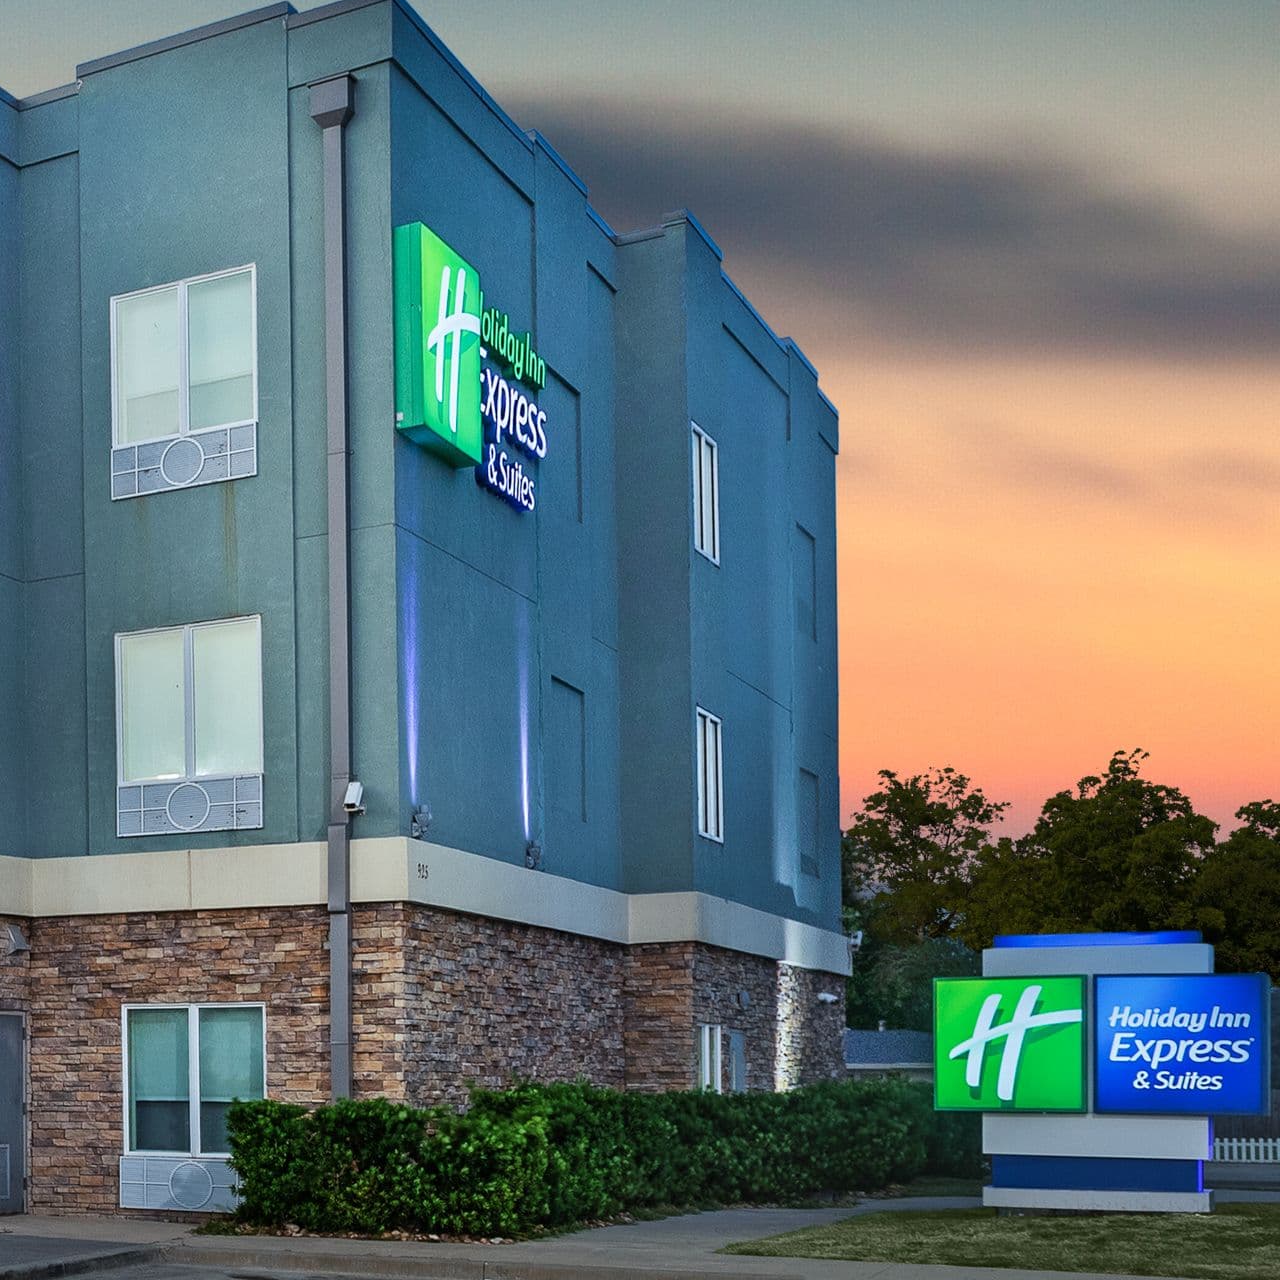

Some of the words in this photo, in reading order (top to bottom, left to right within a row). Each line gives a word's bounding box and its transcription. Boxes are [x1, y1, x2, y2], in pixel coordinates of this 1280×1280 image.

[480, 291, 524, 380] oliday
[525, 332, 546, 388] Inn
[487, 443, 498, 486] &
[499, 451, 535, 511] Suites
[417, 862, 429, 880] 925
[1108, 1006, 1207, 1033] Holiday
[1209, 1006, 1251, 1028] Inn
[1109, 1032, 1251, 1069] Express
[1132, 1070, 1151, 1089] &
[1153, 1071, 1224, 1090] Suites
